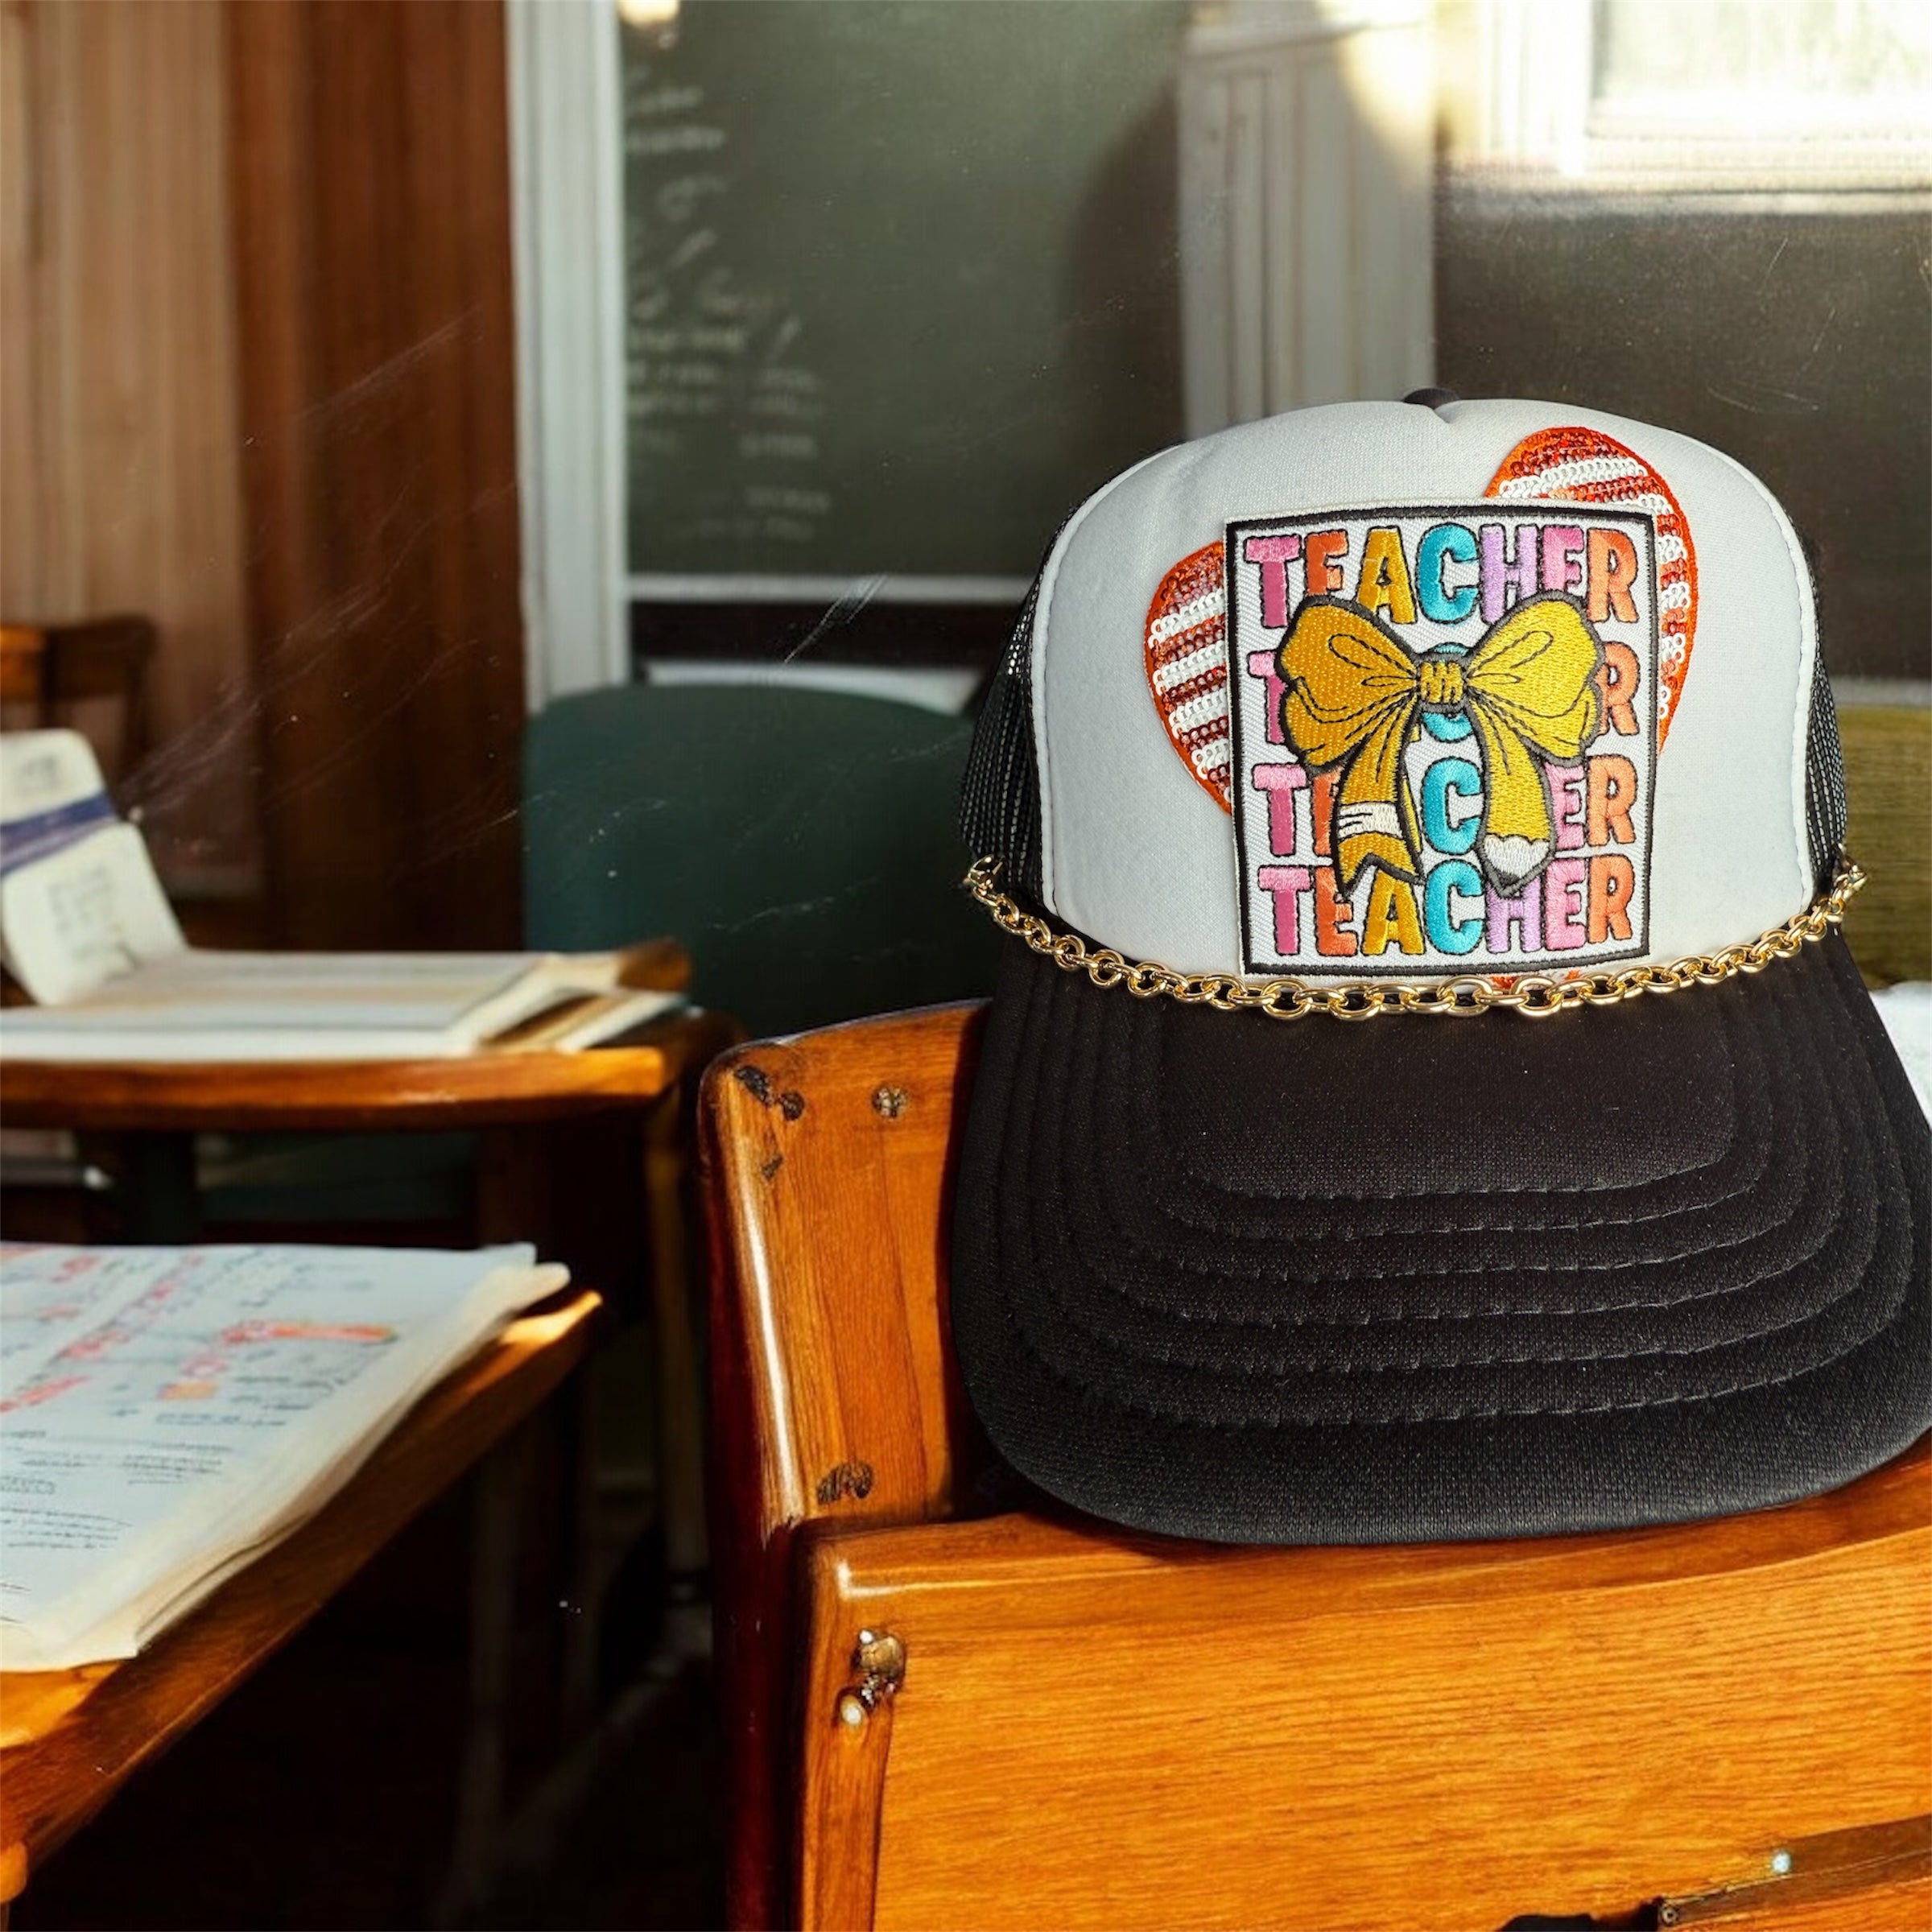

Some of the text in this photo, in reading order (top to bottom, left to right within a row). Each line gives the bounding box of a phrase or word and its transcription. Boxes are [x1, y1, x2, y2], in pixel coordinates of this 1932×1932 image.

[1245, 523, 1638, 629] TEACHER
[1252, 753, 1638, 857] TCER
[1258, 853, 1635, 956] TEACHER
